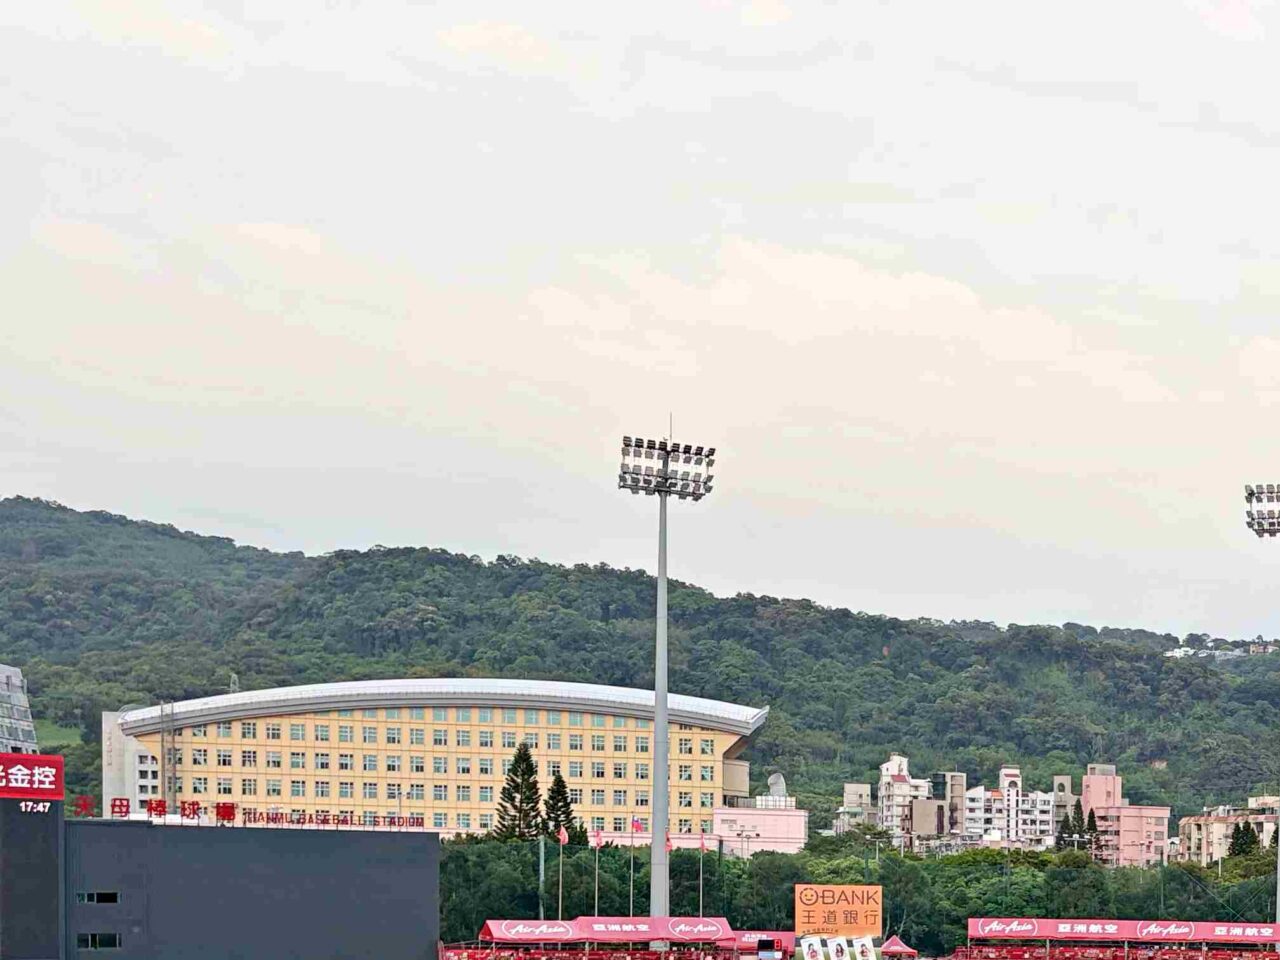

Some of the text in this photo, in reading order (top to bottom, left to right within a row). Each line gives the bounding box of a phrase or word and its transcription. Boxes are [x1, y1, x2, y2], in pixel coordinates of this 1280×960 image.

[0, 765, 57, 789] 金控
[19, 802, 51, 813] 17:47
[299, 812, 365, 827] BASEBALL
[373, 815, 424, 827] STADIUM
[801, 910, 879, 926] 王道銀行
[1057, 922, 1118, 934] 亞洲航空
[1214, 926, 1274, 937] 亞洲航空
